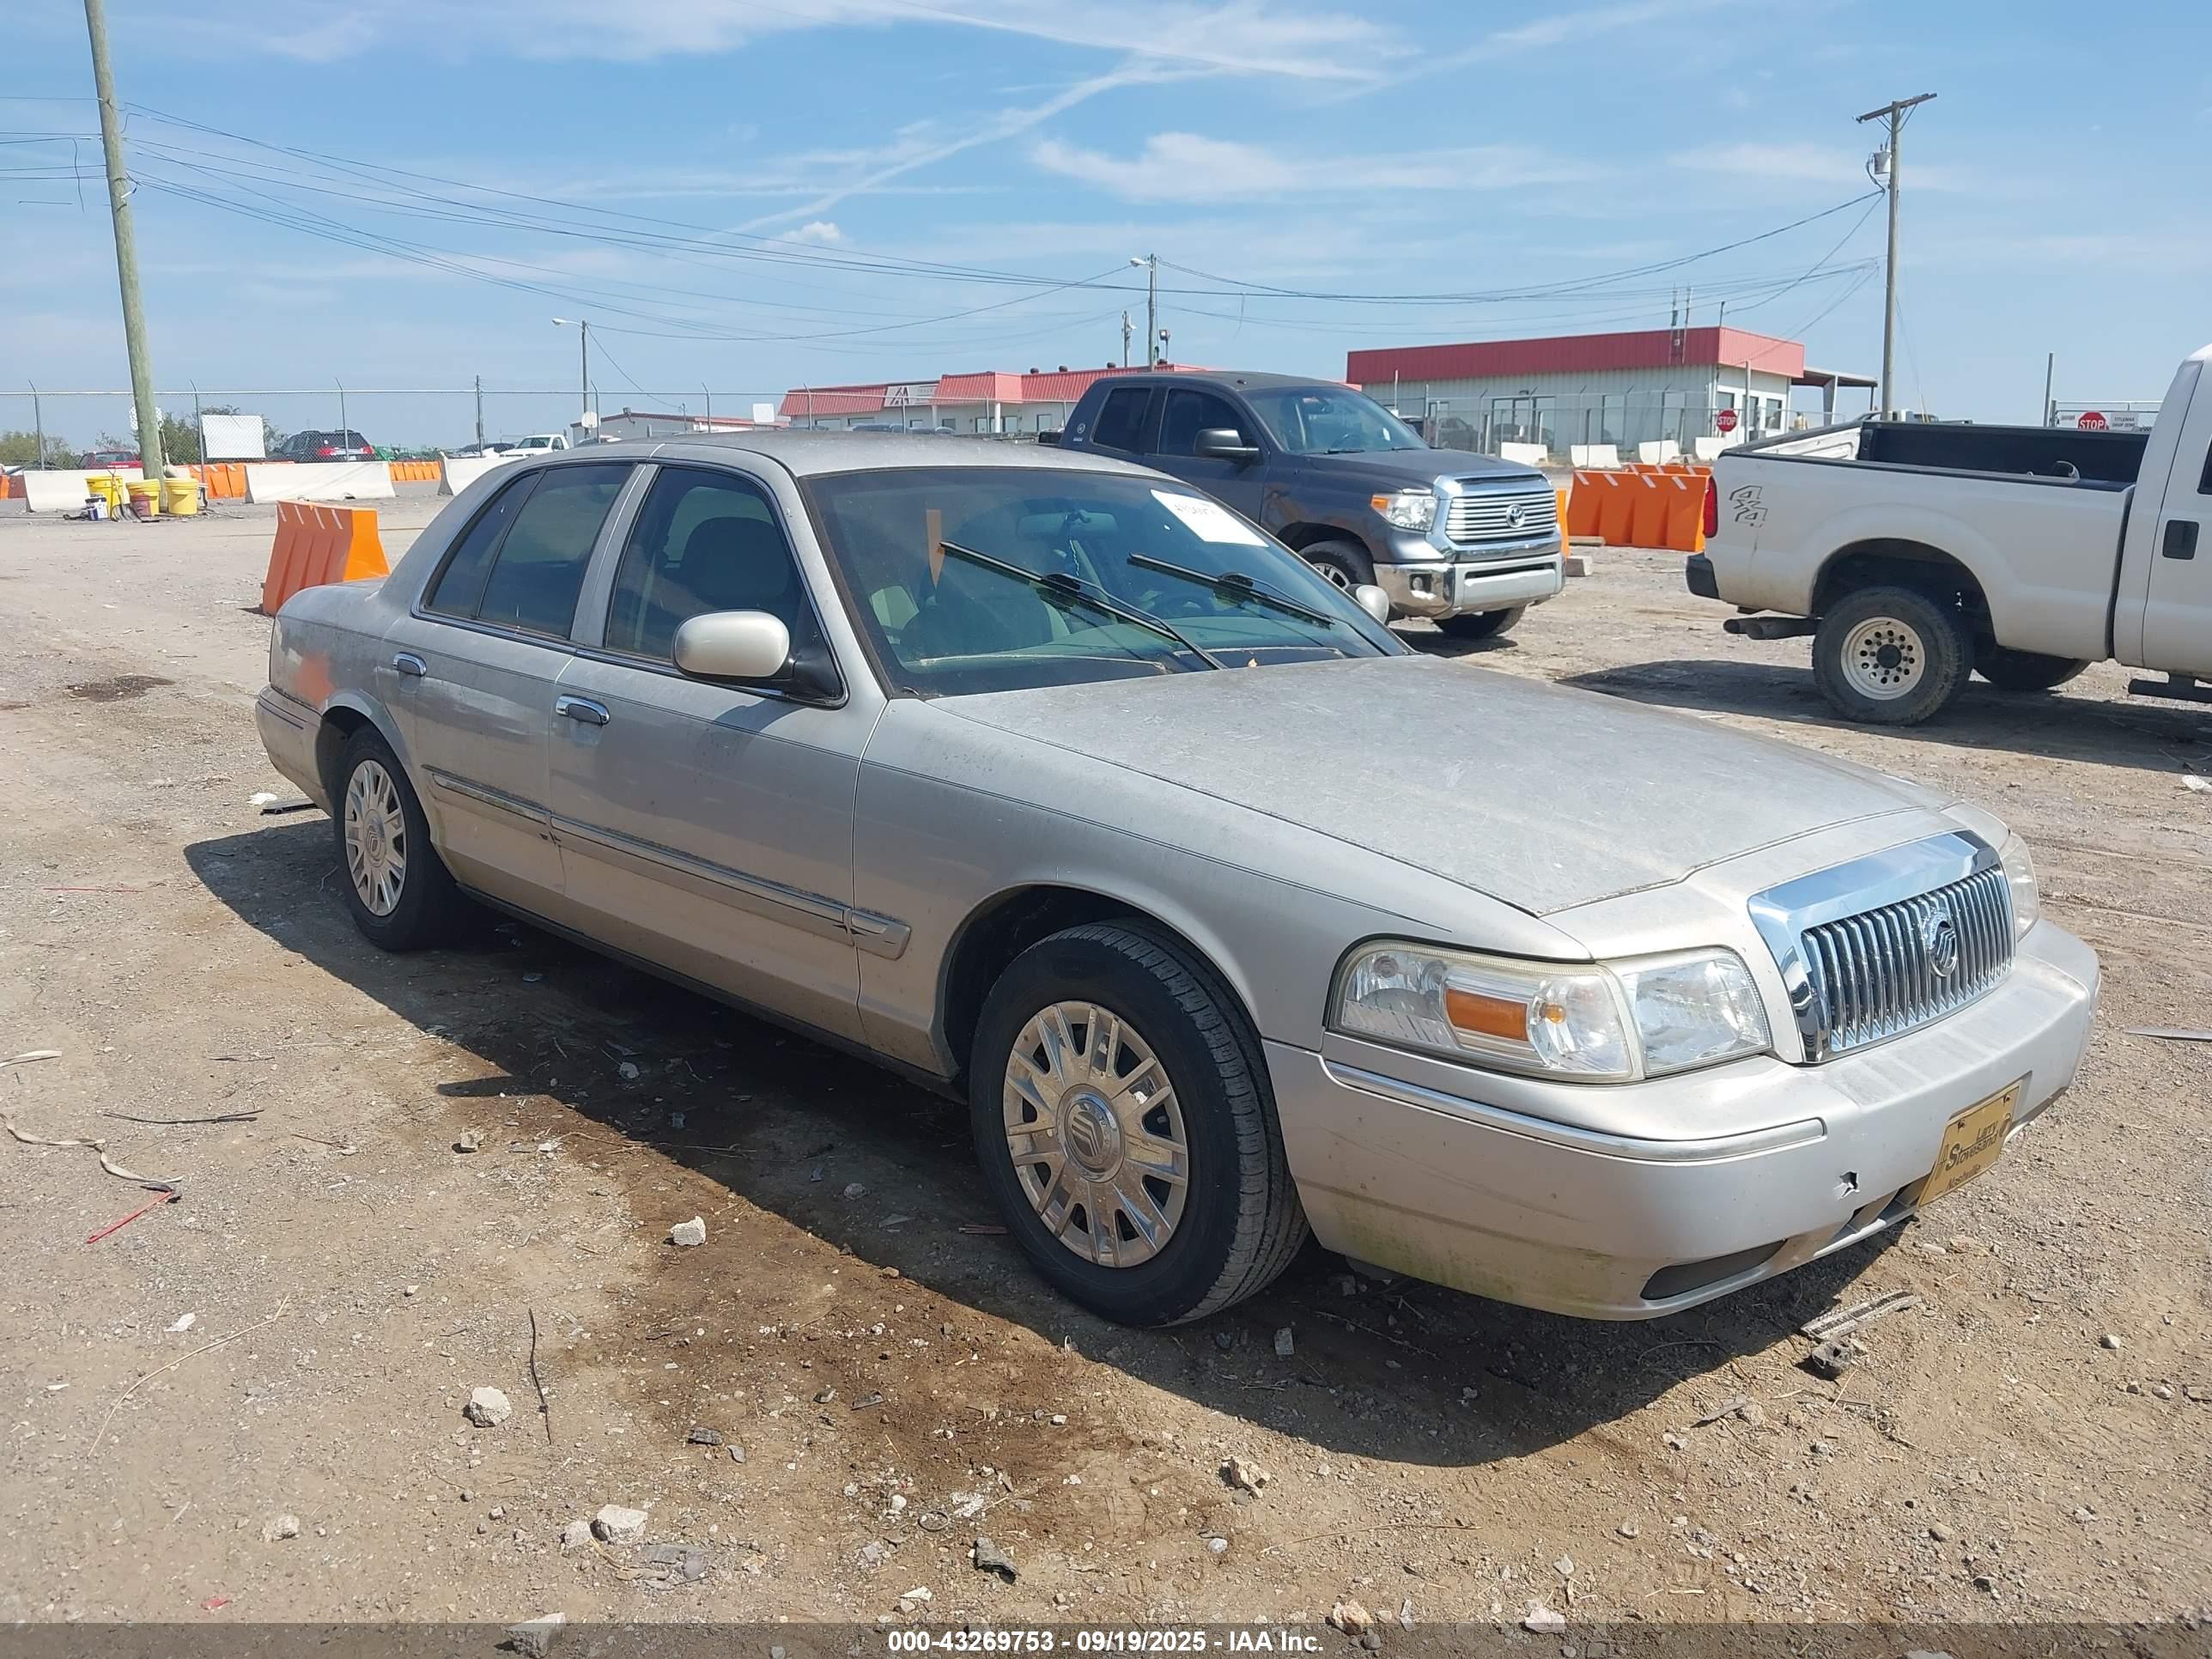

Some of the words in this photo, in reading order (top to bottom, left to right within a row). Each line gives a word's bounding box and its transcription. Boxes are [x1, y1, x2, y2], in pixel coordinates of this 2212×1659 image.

[1717, 416, 1736, 426] STOP
[2079, 419, 2104, 429] STOP
[1977, 1121, 1999, 1139] Larry
